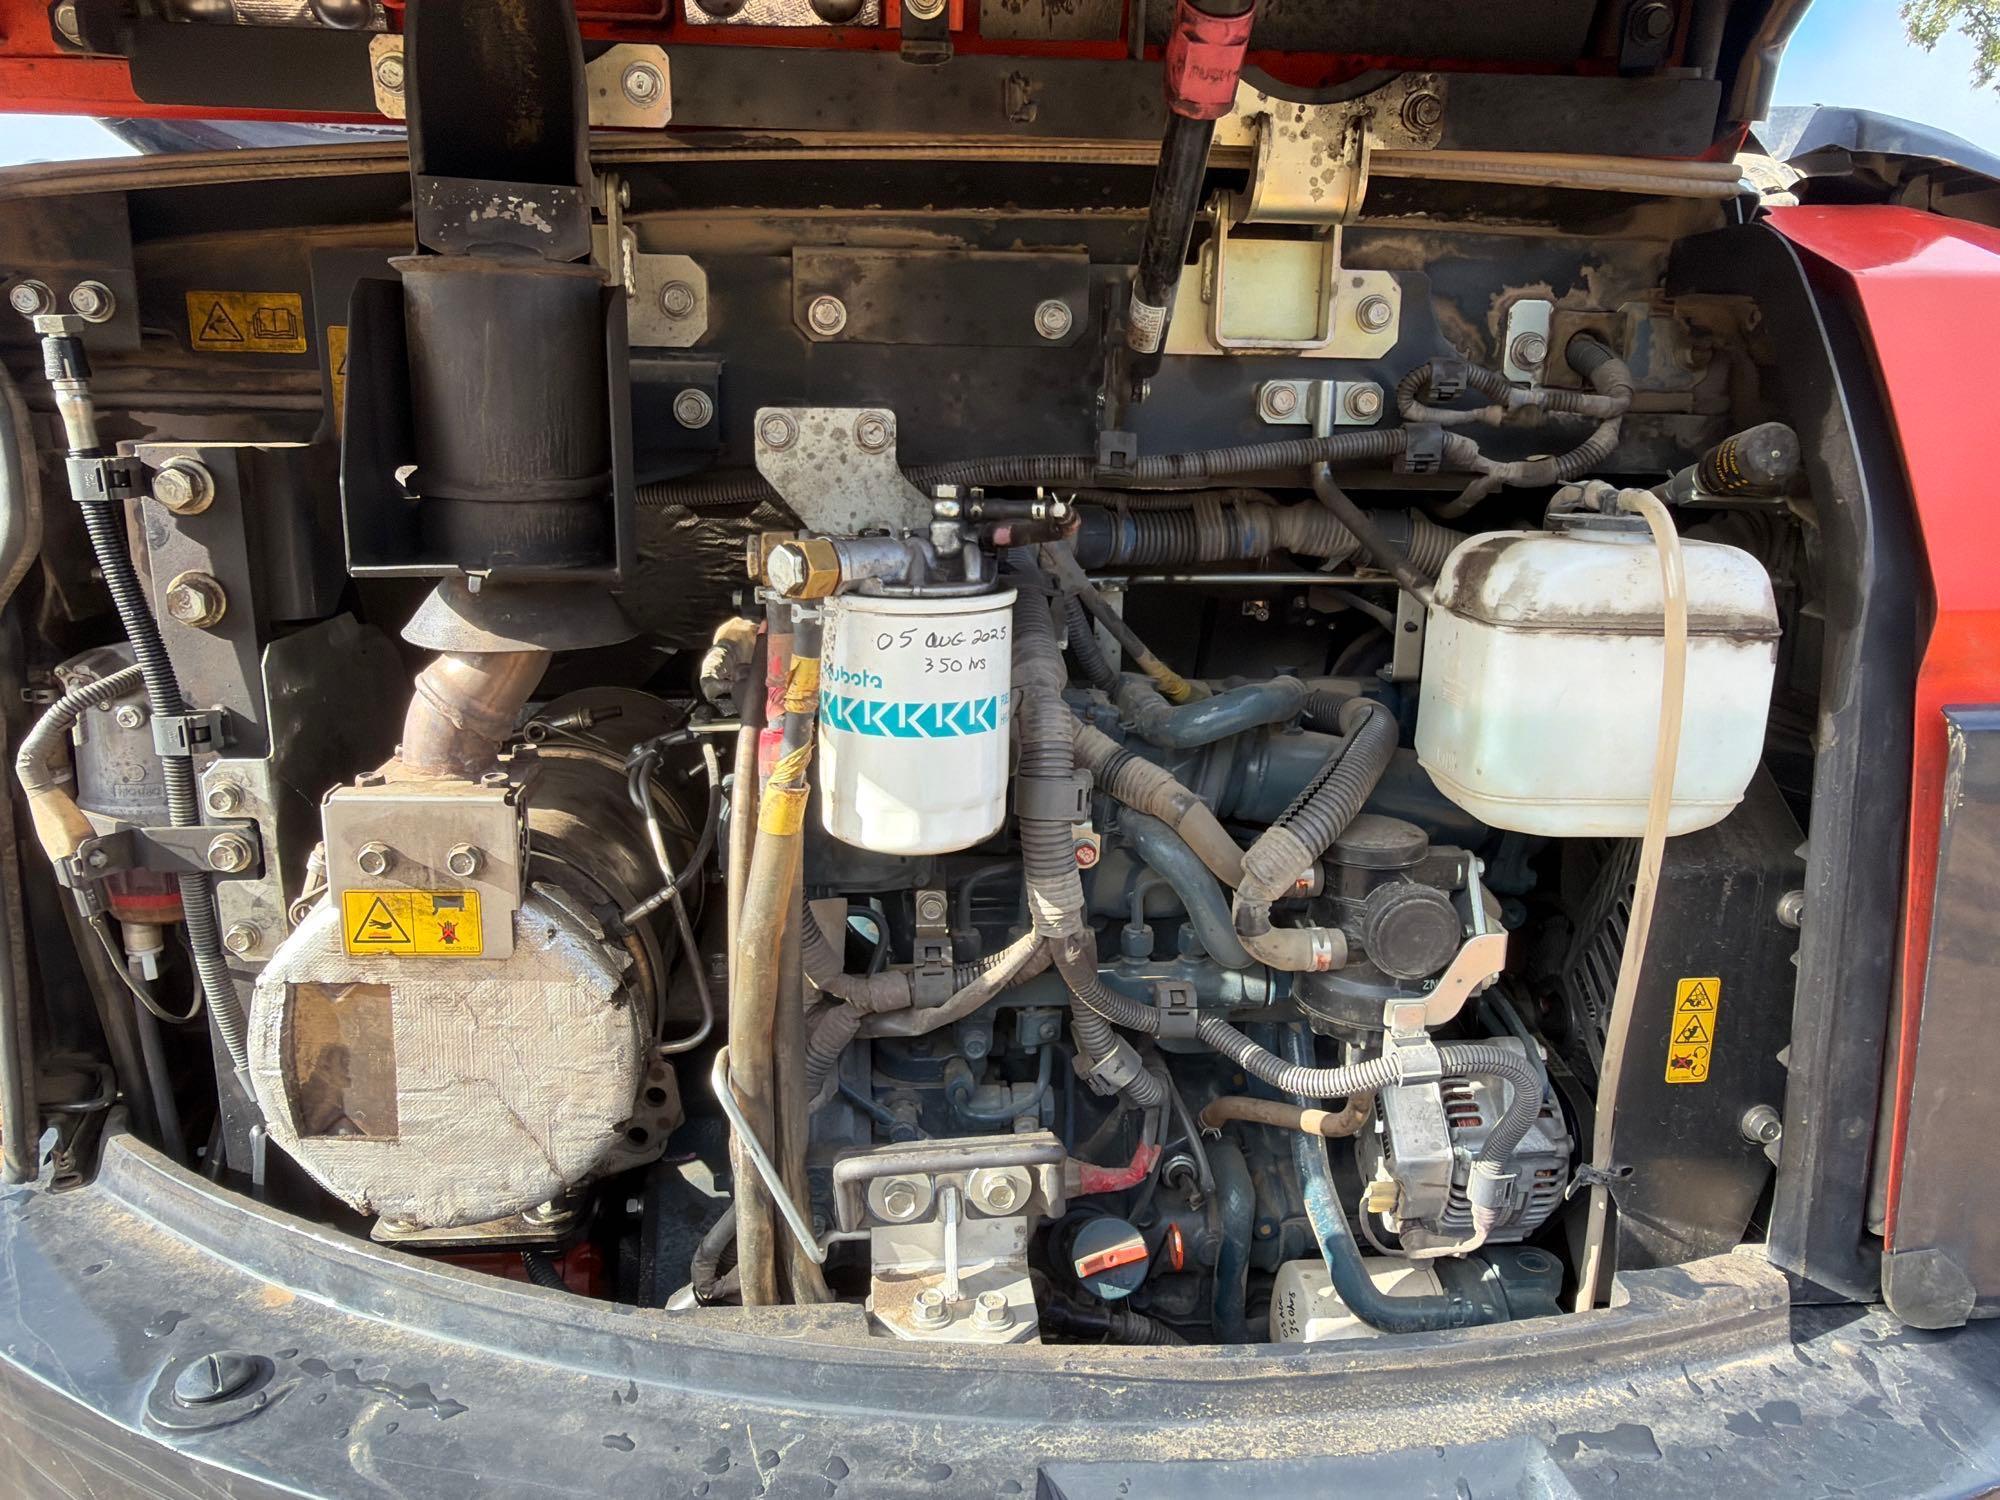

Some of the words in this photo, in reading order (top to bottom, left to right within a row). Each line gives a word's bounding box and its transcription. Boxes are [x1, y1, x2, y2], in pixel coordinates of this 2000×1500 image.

[877, 627, 918, 650] 05
[971, 625, 1006, 645] 2025
[924, 657, 962, 673] 350
